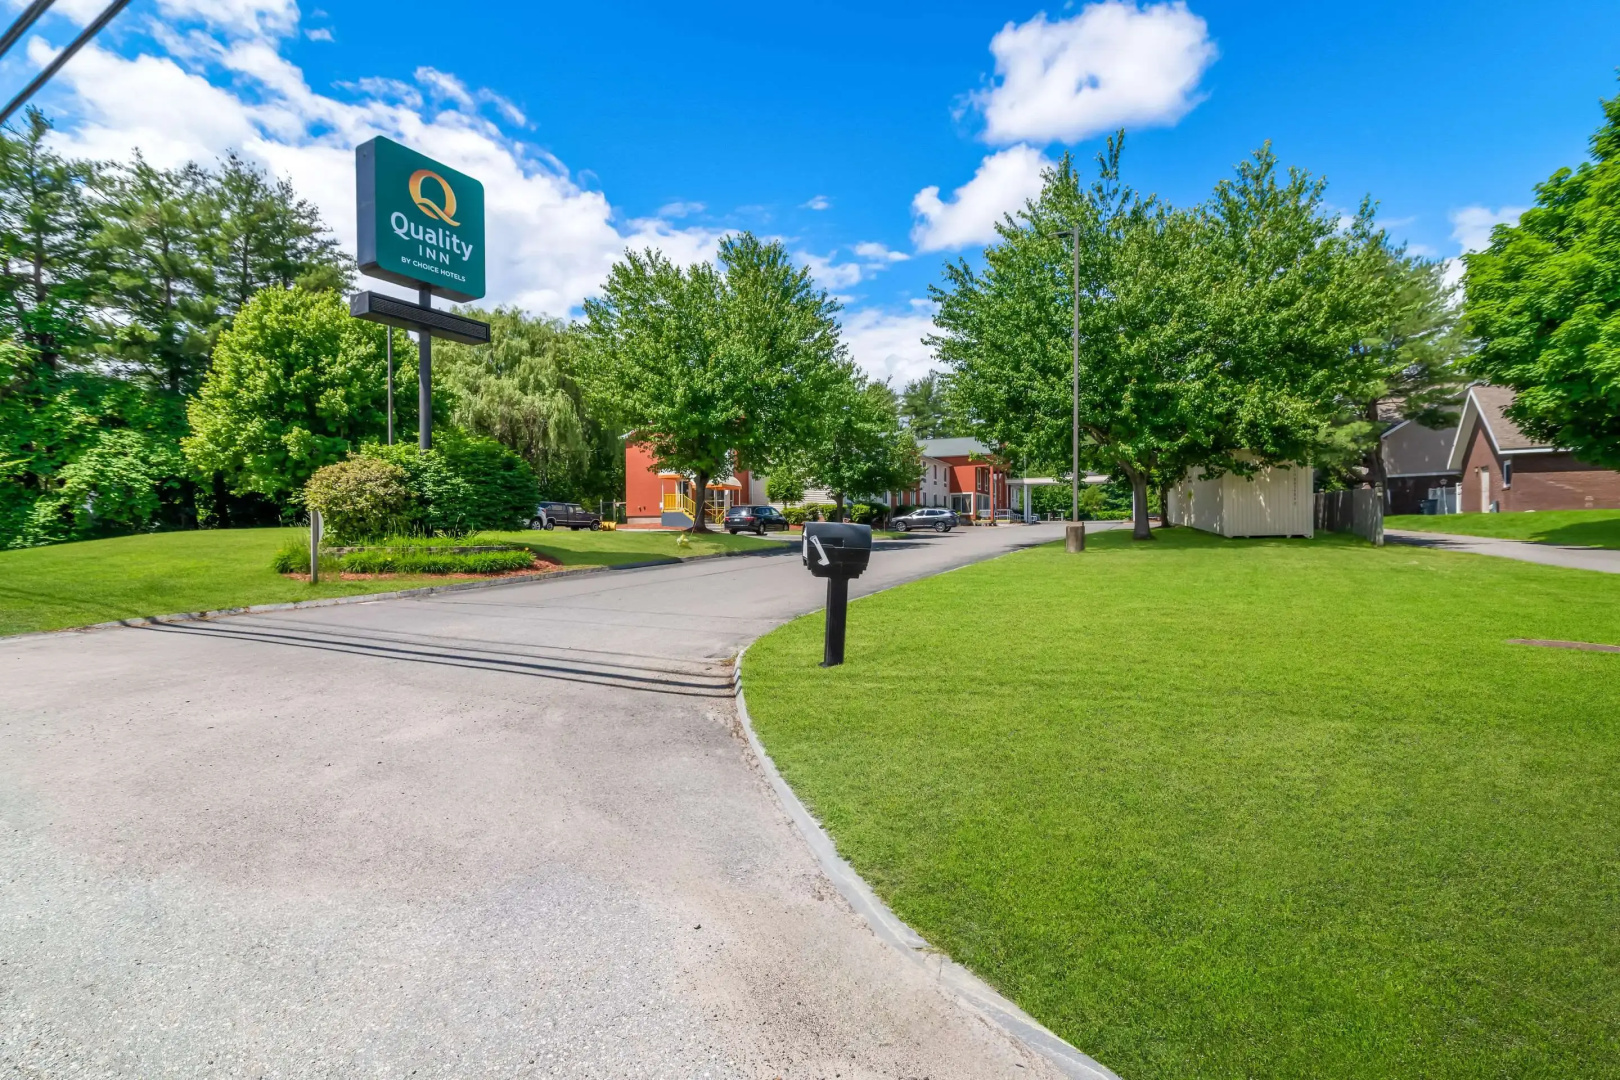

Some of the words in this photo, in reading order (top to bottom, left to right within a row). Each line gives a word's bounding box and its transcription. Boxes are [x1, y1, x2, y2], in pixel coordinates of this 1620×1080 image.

[390, 211, 473, 261] Quality
[419, 244, 450, 266] INN
[401, 256, 411, 264] BY
[412, 260, 440, 274] CHOICE
[440, 269, 466, 282] HOTELS
